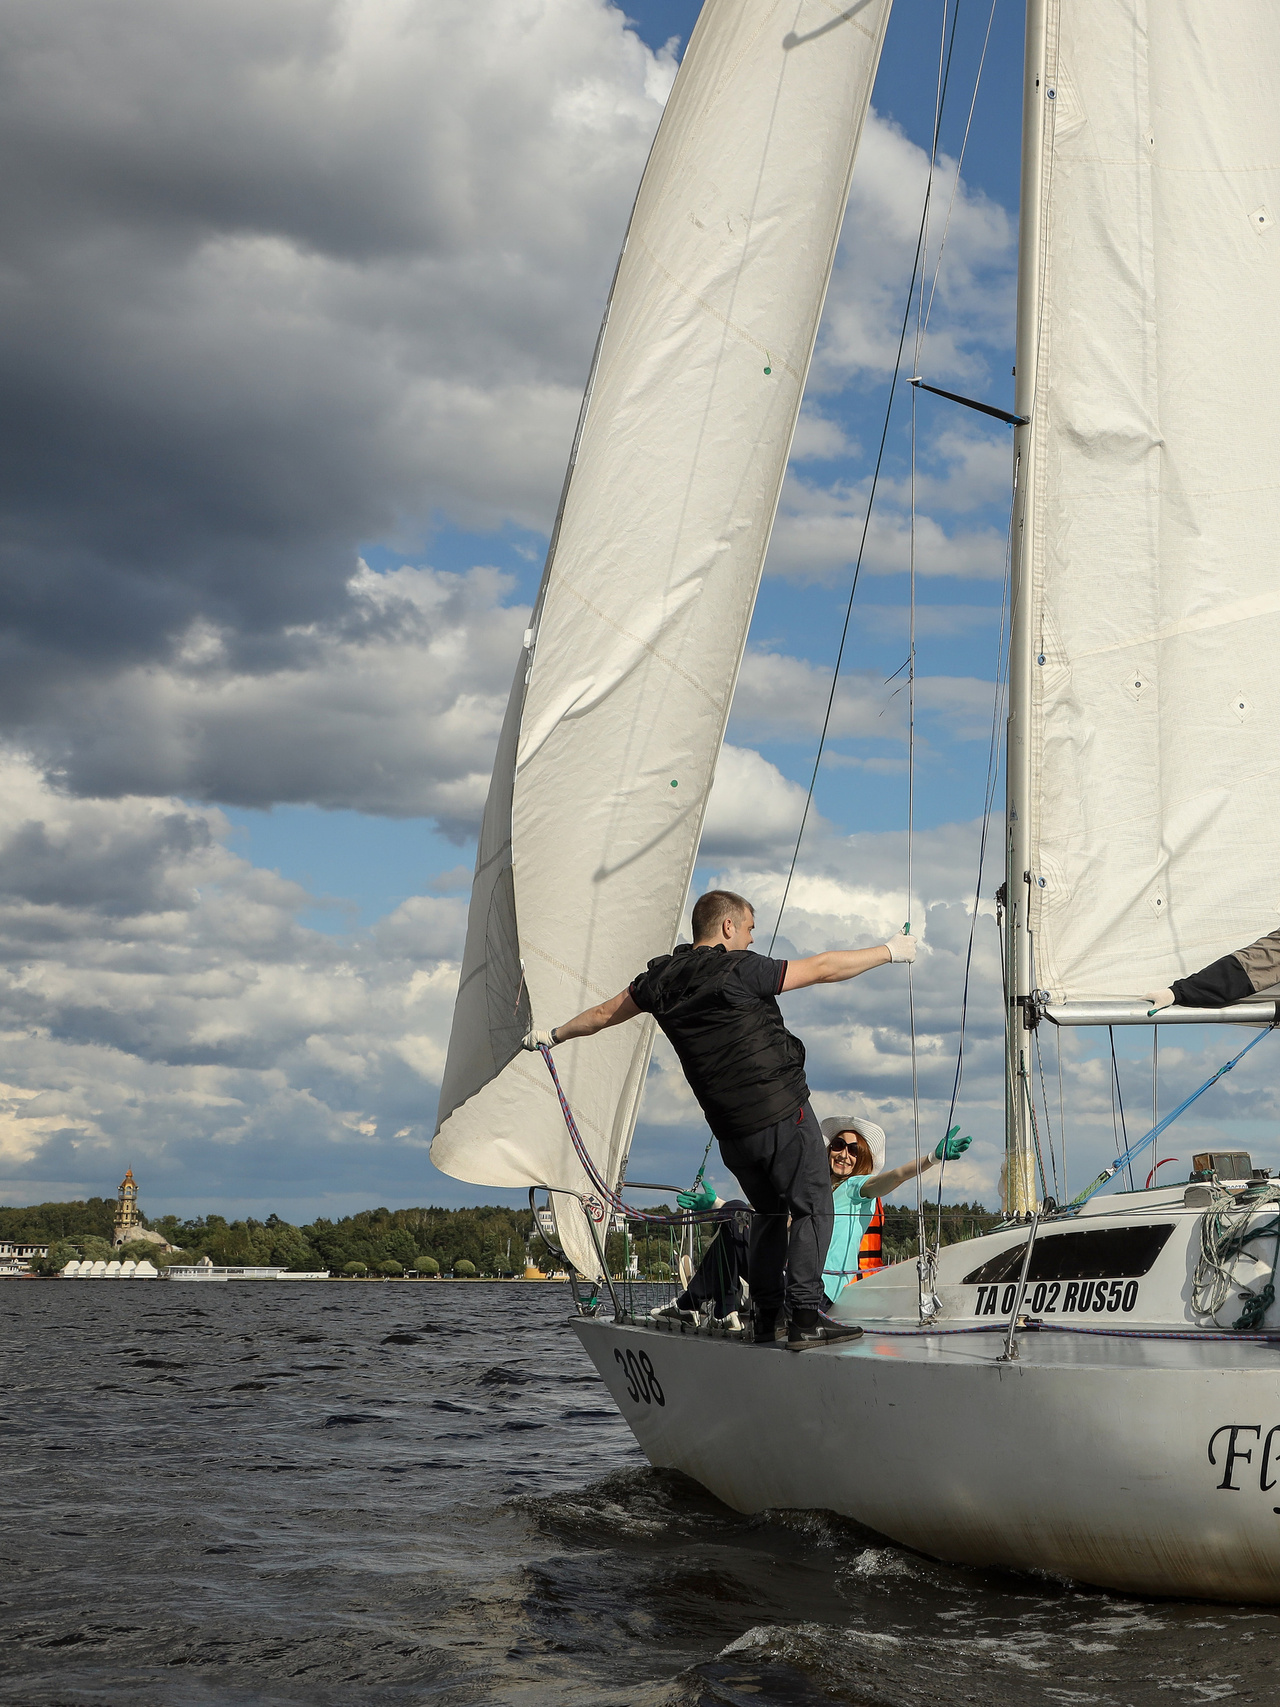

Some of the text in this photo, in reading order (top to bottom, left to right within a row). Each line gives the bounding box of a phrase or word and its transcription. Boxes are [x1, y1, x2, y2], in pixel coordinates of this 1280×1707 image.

[974, 1281, 1139, 1316] TA 0-02 RUS50
[613, 1348, 666, 1407] 308
